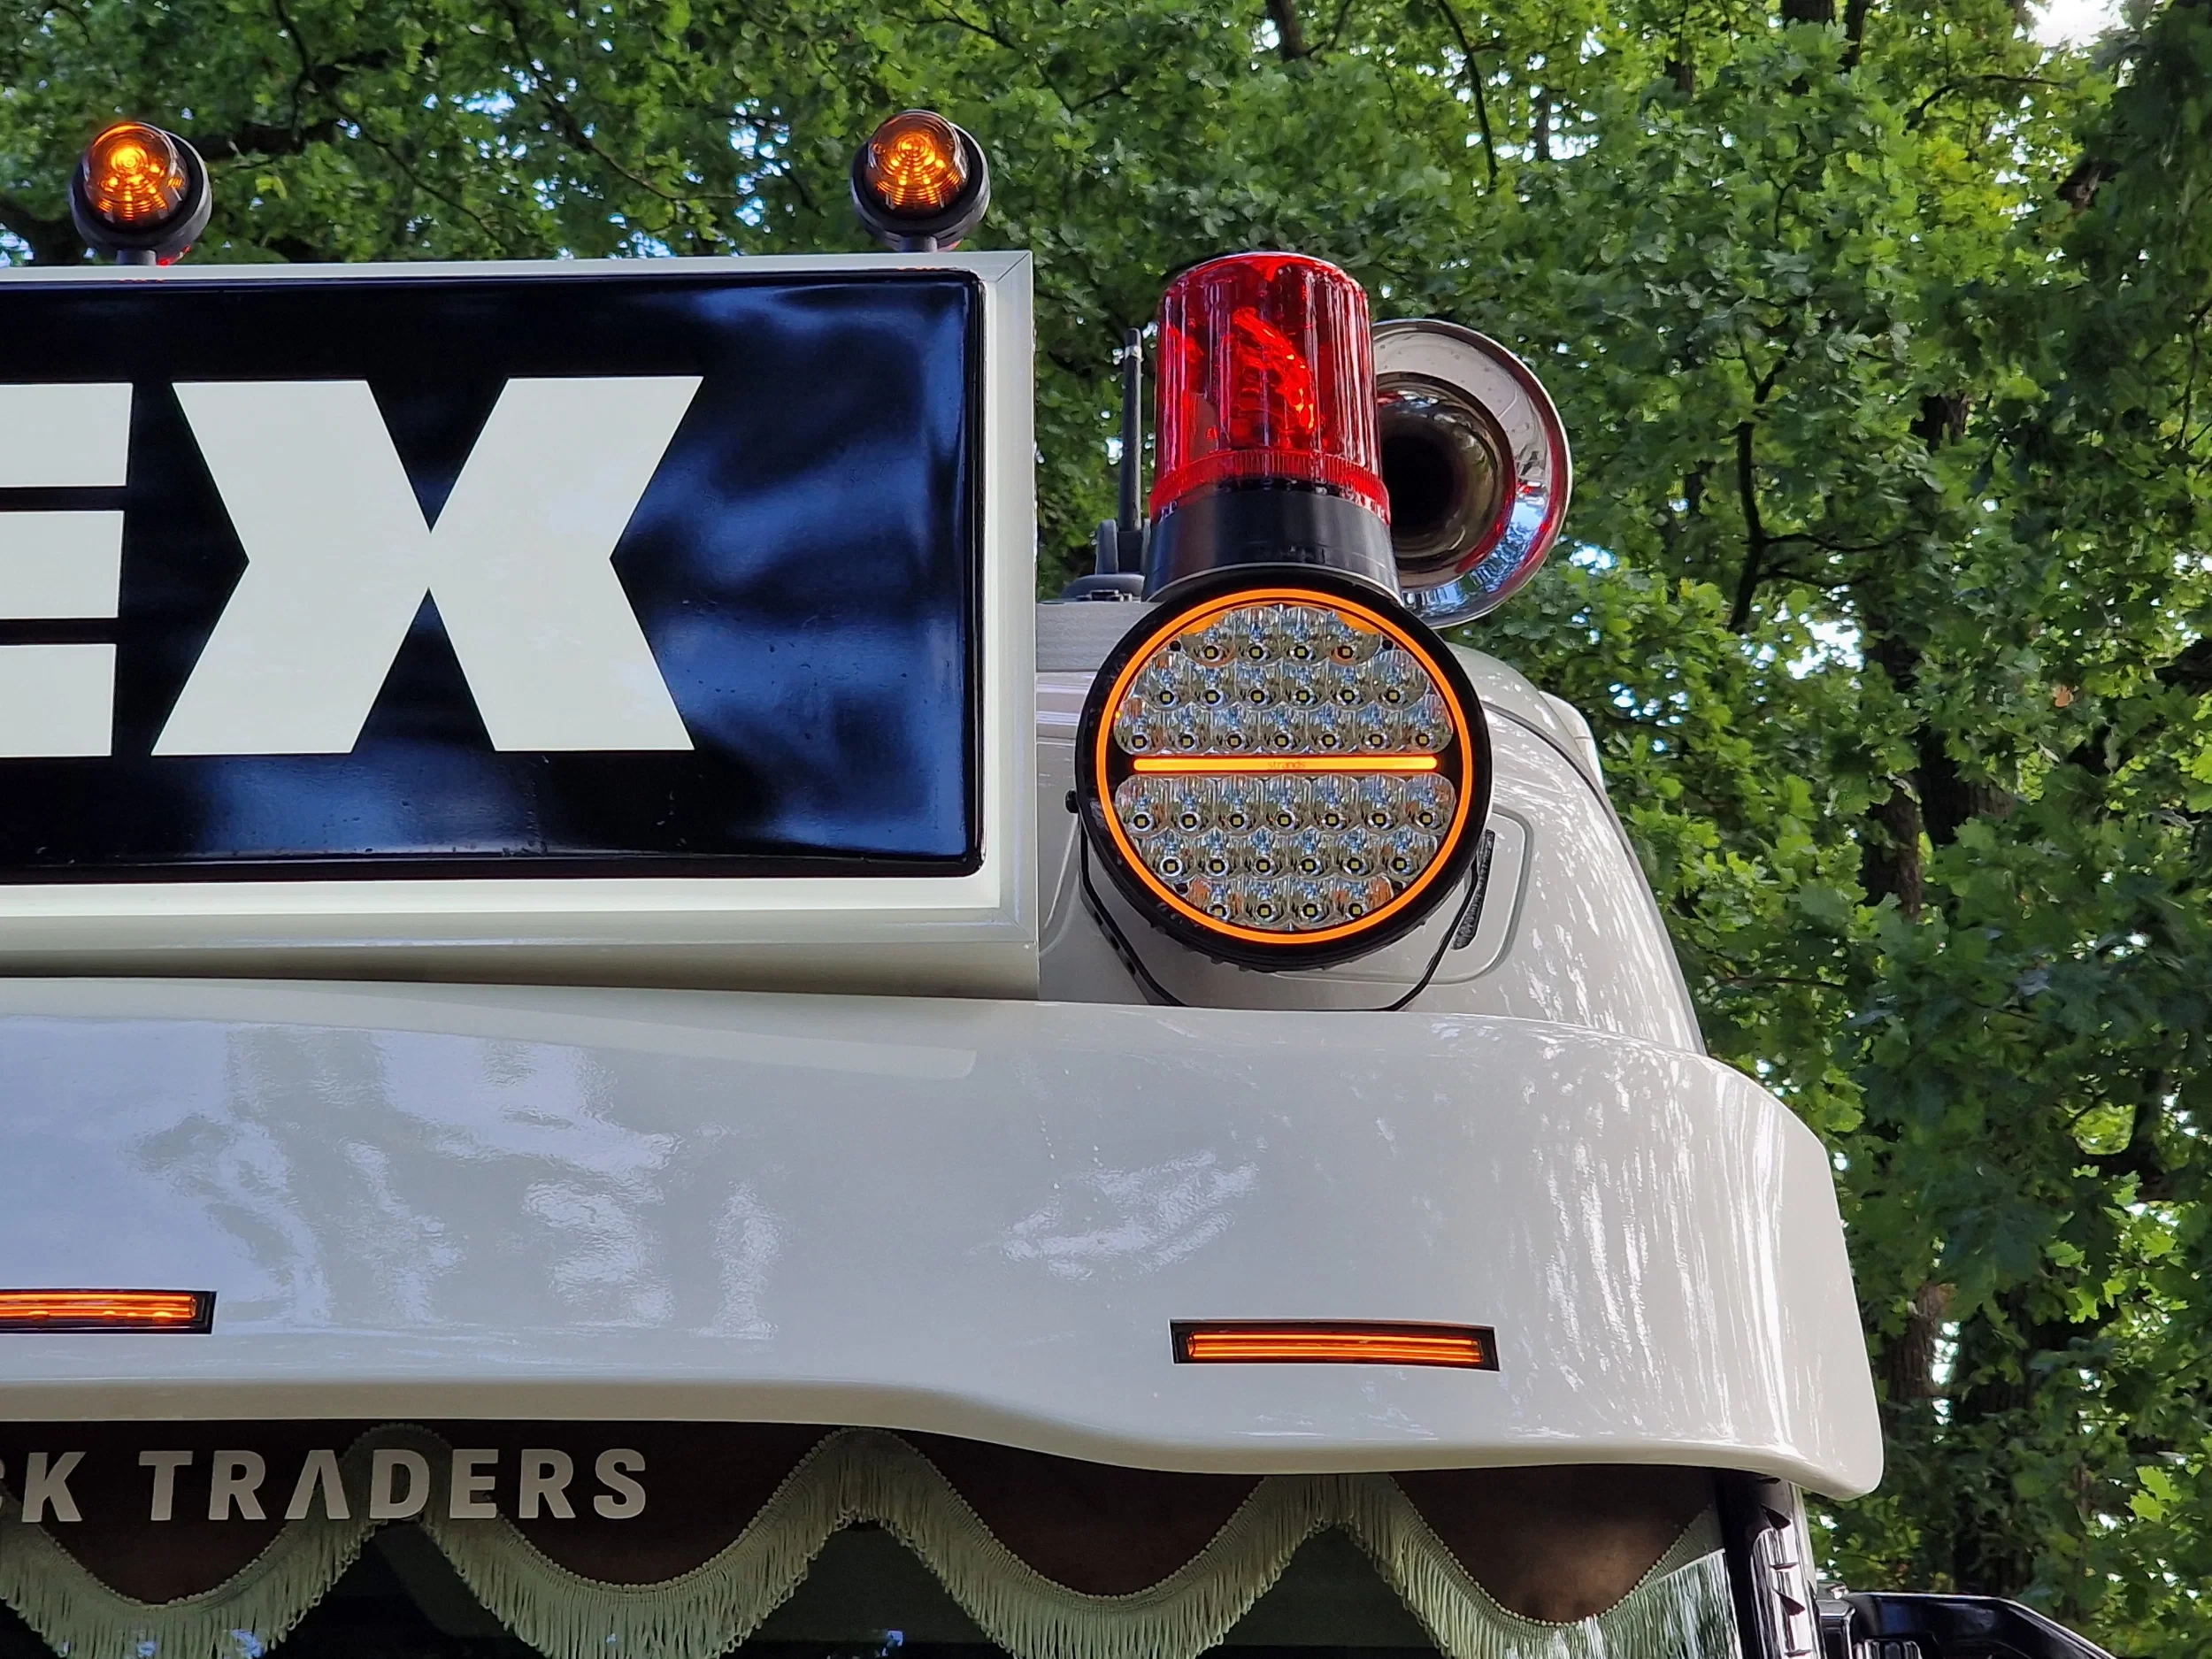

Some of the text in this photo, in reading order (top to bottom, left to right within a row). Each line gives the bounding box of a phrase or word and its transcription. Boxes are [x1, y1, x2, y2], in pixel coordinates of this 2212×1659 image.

[1267, 760, 1306, 769] strands
[0, 1448, 647, 1522] K TRADERS
